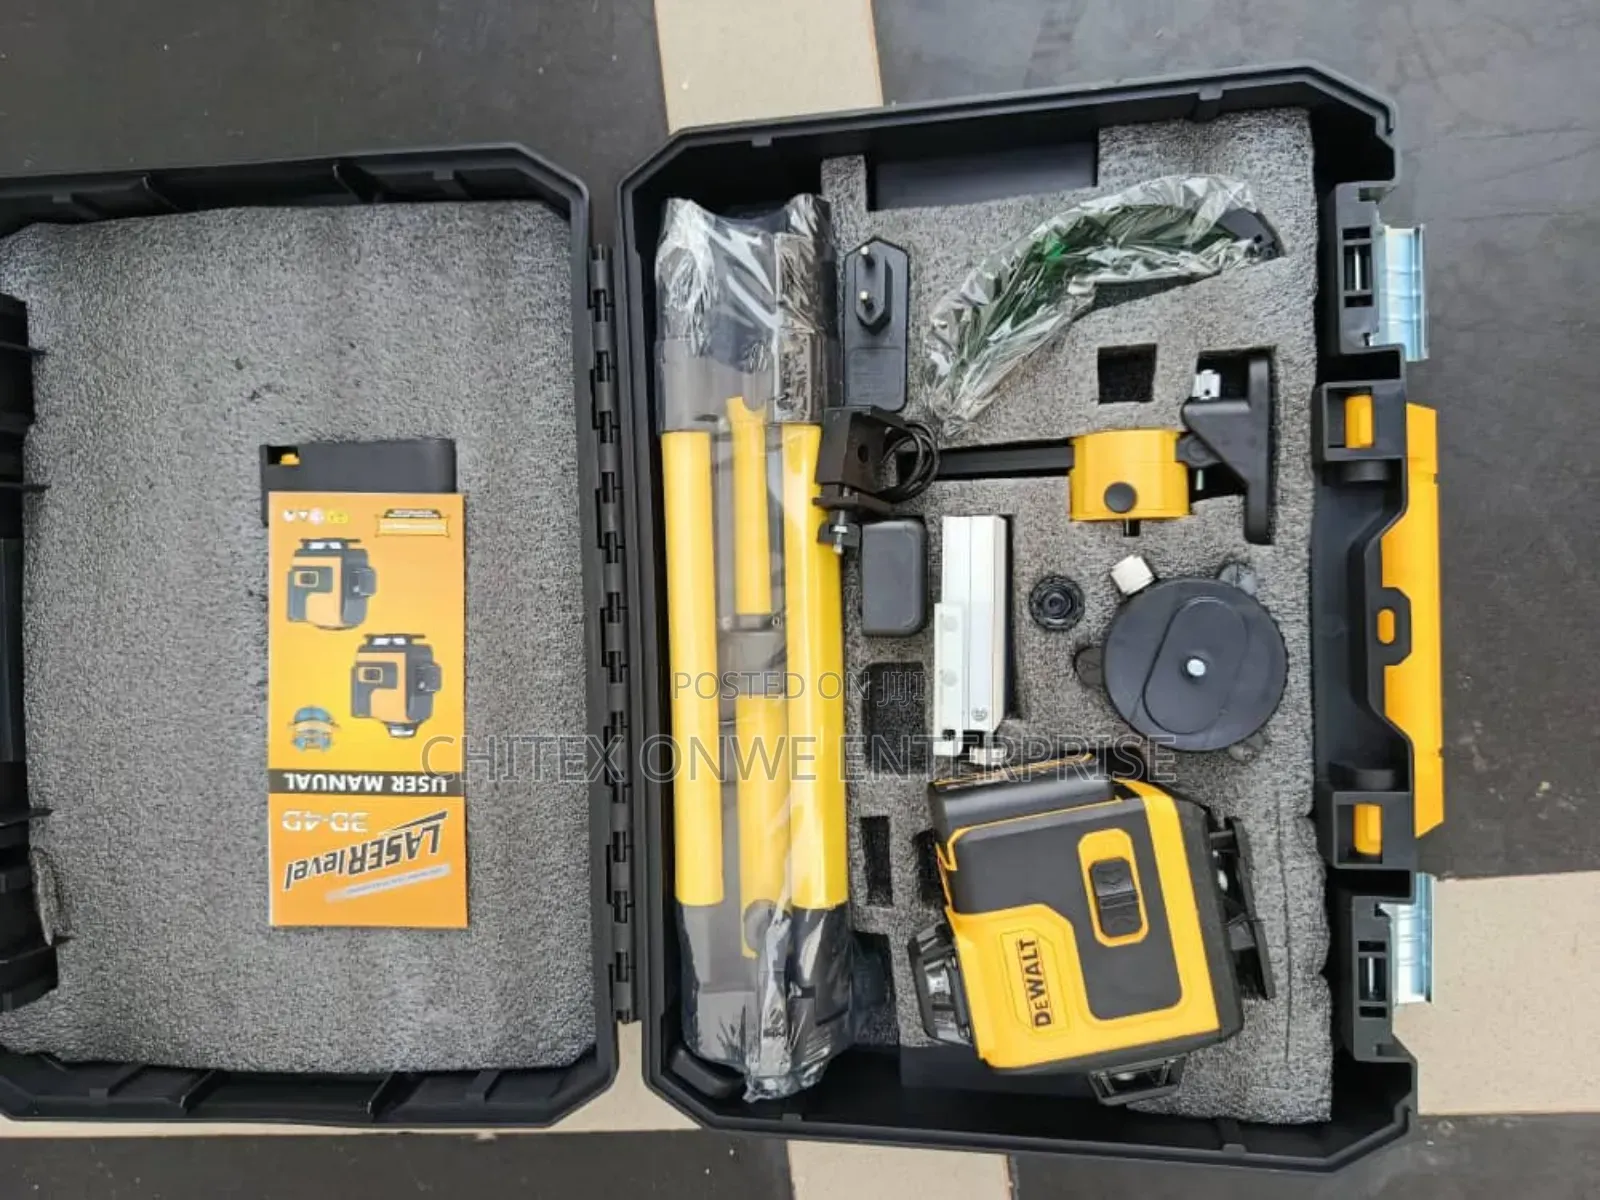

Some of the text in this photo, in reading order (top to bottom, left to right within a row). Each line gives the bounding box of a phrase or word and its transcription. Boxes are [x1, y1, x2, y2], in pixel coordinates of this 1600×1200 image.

[283, 773, 447, 794] USER MANUAL
[281, 810, 370, 833] 3D-4D
[282, 849, 346, 891] level
[349, 822, 443, 876] LASER
[1018, 938, 1052, 1027] DEWALT
